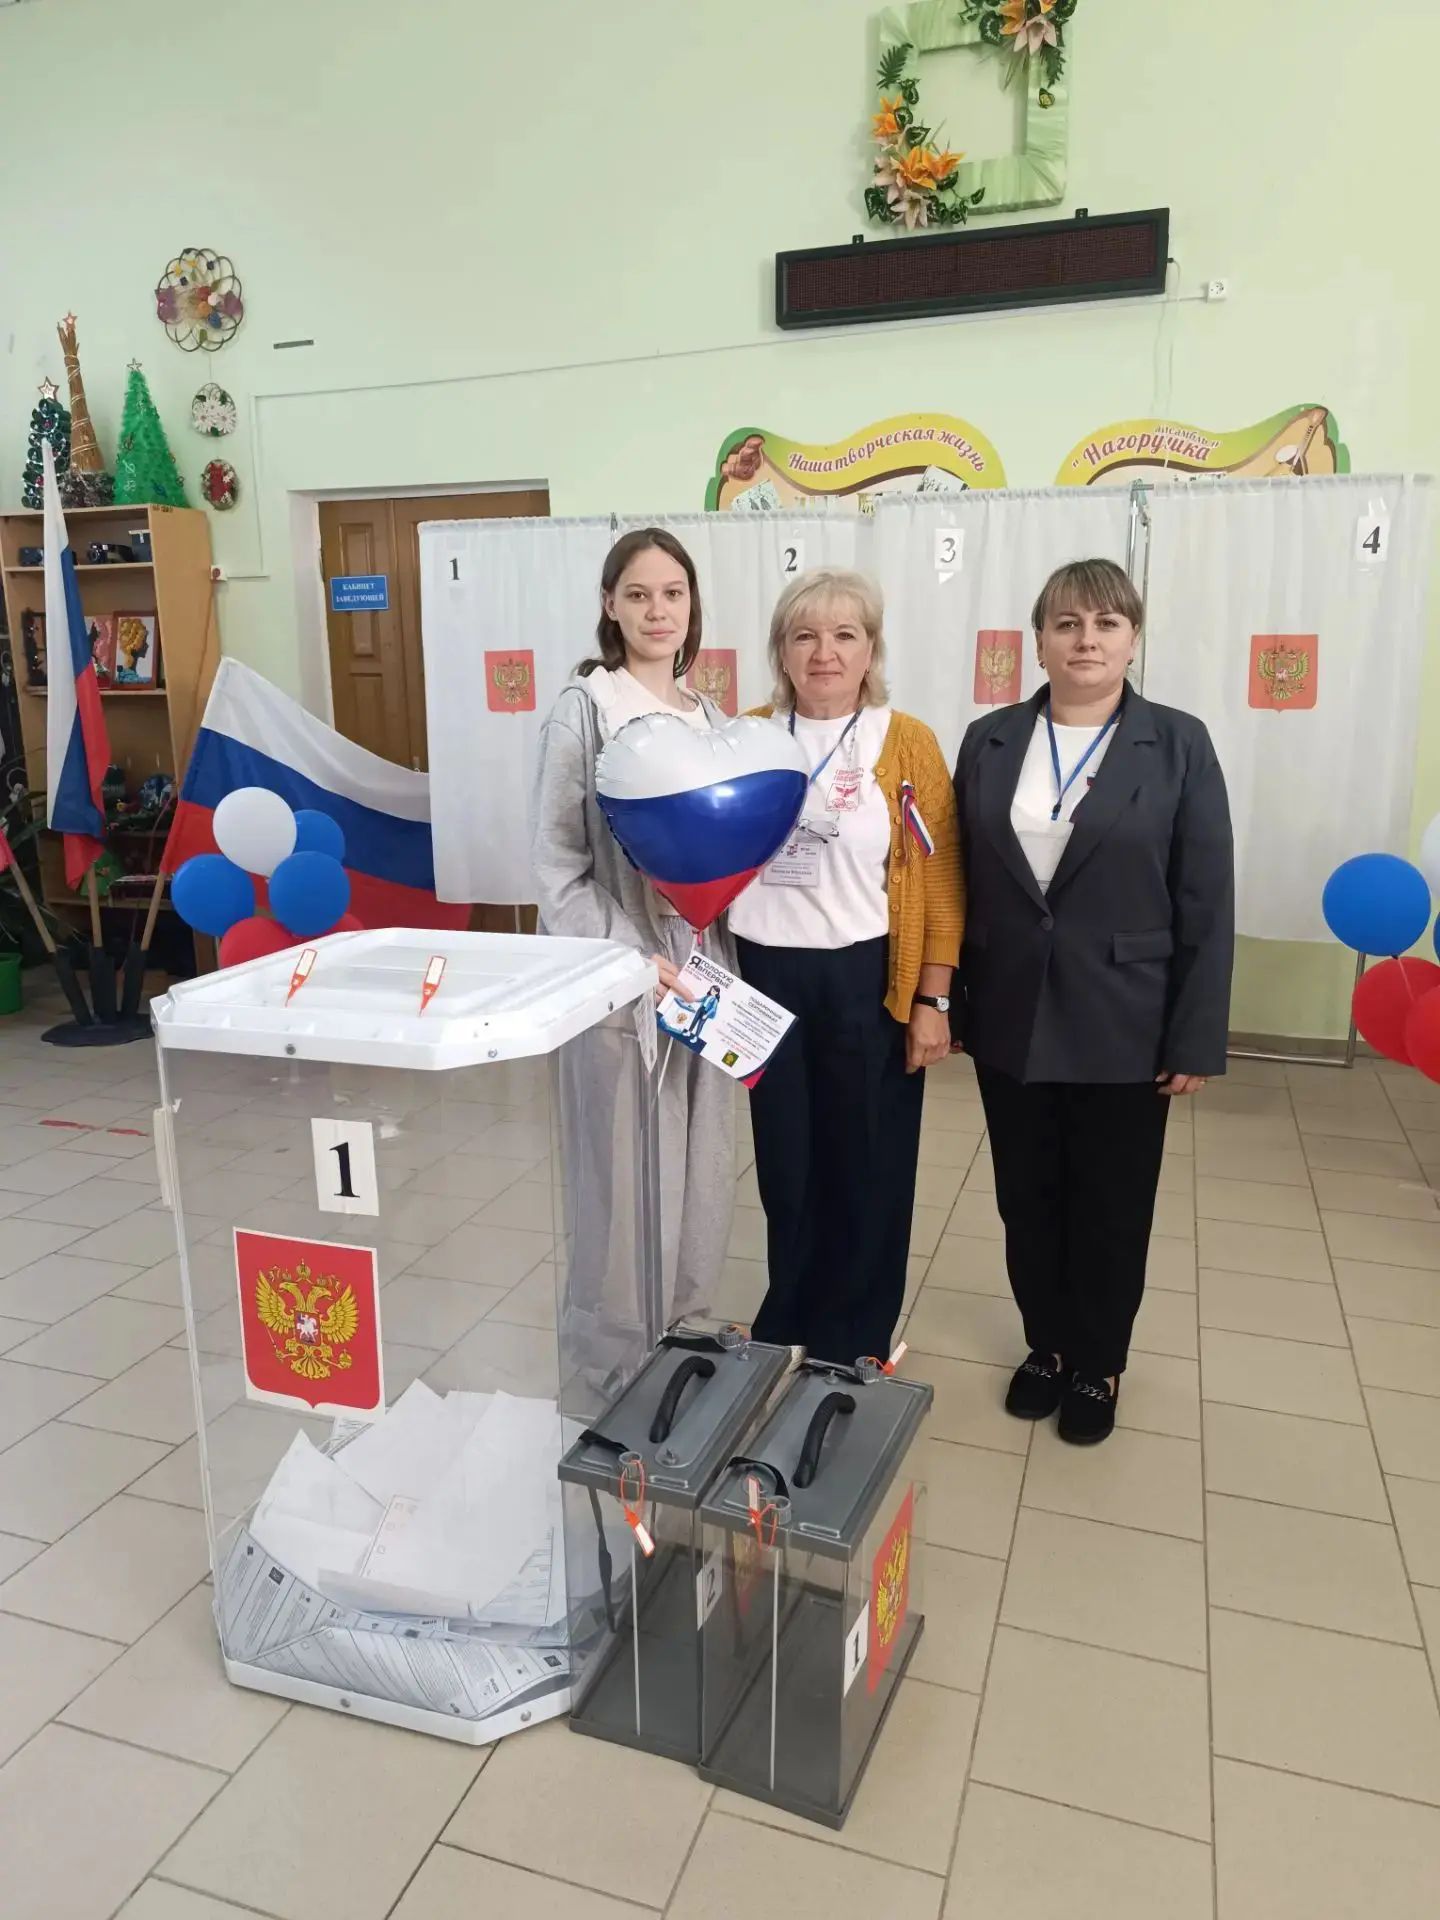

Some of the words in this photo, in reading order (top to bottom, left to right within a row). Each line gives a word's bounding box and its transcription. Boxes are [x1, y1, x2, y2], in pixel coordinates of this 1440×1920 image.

[788, 452, 832, 472] Наша
[836, 428, 935, 469] творческая
[937, 430, 985, 472] жизнь
[940, 537, 956, 563] 3
[1362, 526, 1380, 554] 4
[449, 557, 460, 580] 1
[784, 547, 797, 571] 2
[689, 955, 702, 968] Я
[701, 960, 734, 983] ГОЛОСУЮ
[698, 966, 731, 989] ВПЕРВЫЕ
[329, 1141, 361, 1198] 1
[707, 1568, 715, 1608] 2
[853, 1632, 860, 1671] 1
